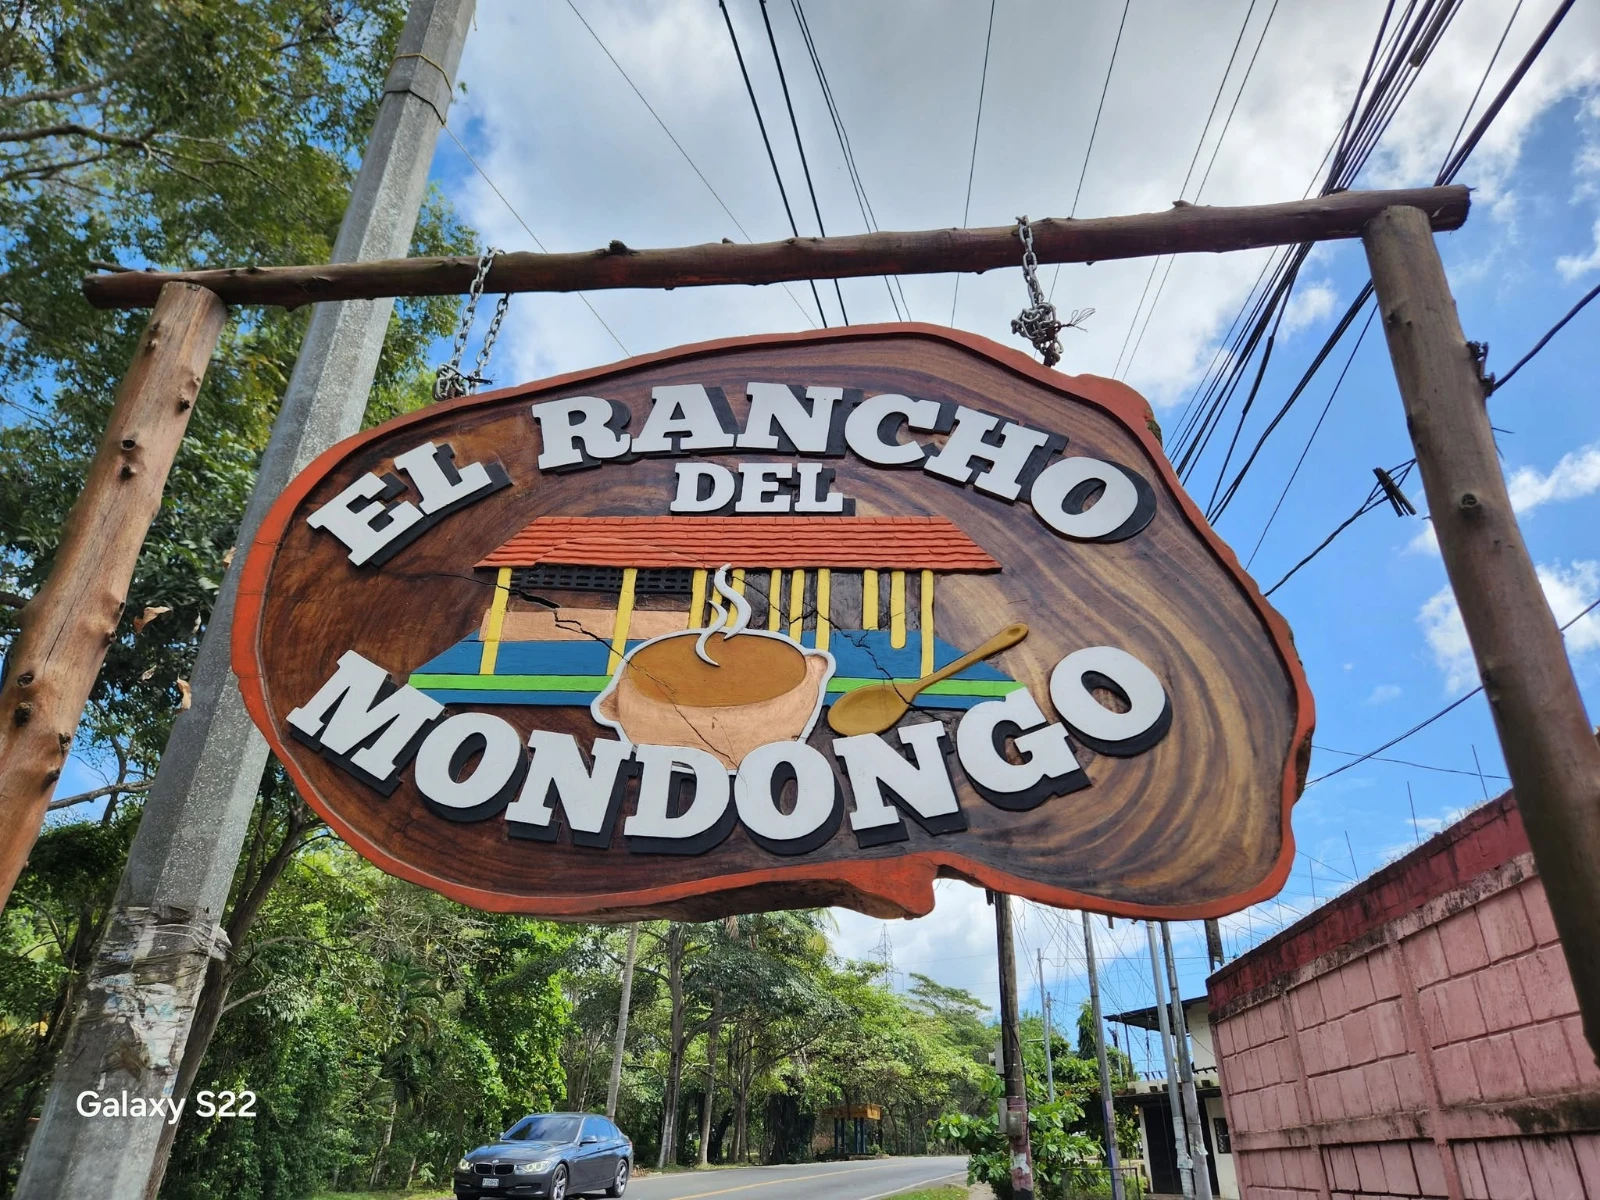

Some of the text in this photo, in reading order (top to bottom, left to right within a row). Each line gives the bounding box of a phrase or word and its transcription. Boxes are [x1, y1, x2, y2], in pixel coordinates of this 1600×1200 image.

[306, 381, 1140, 566] EL RANCHO
[670, 462, 845, 514] DEL
[285, 645, 1167, 843] MONDONGO
